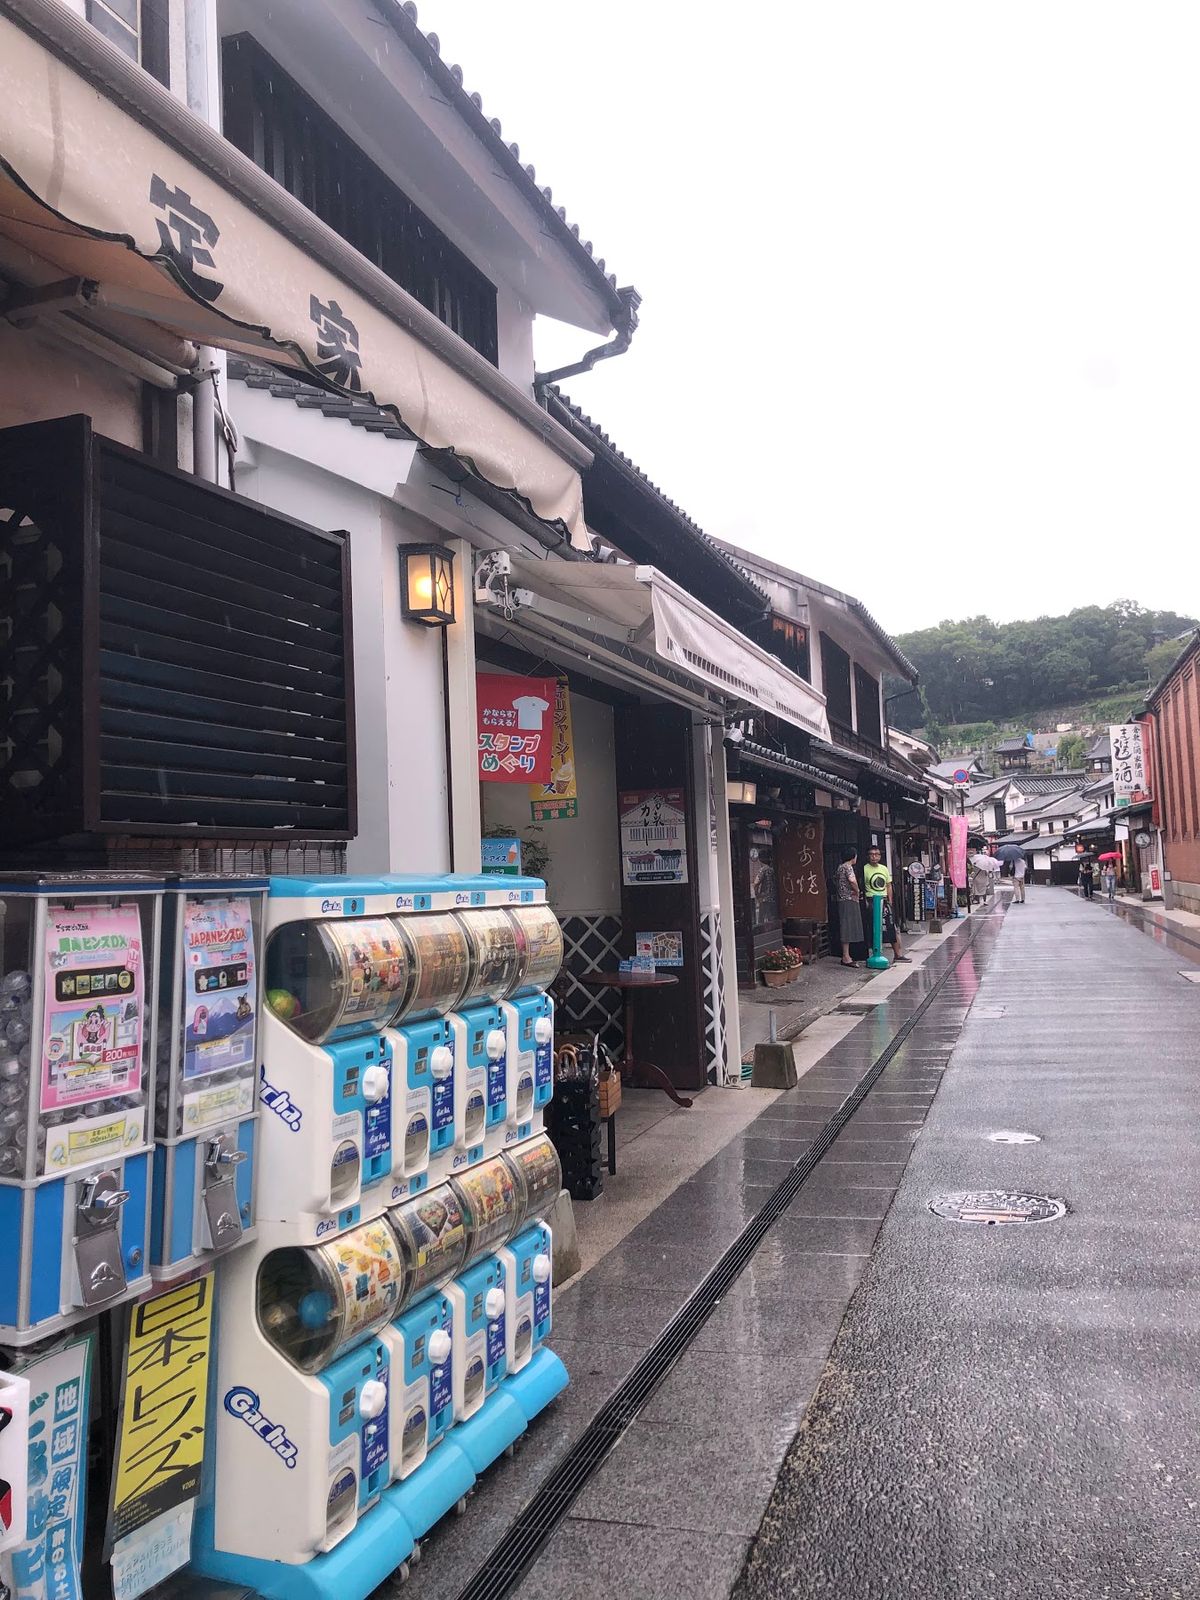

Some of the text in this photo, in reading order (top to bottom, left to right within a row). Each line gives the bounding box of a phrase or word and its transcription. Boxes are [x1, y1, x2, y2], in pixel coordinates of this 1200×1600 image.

[478, 733, 541, 753] スタンプ
[481, 753, 536, 774] めぐり
[47, 1385, 79, 1521] 地域限定
